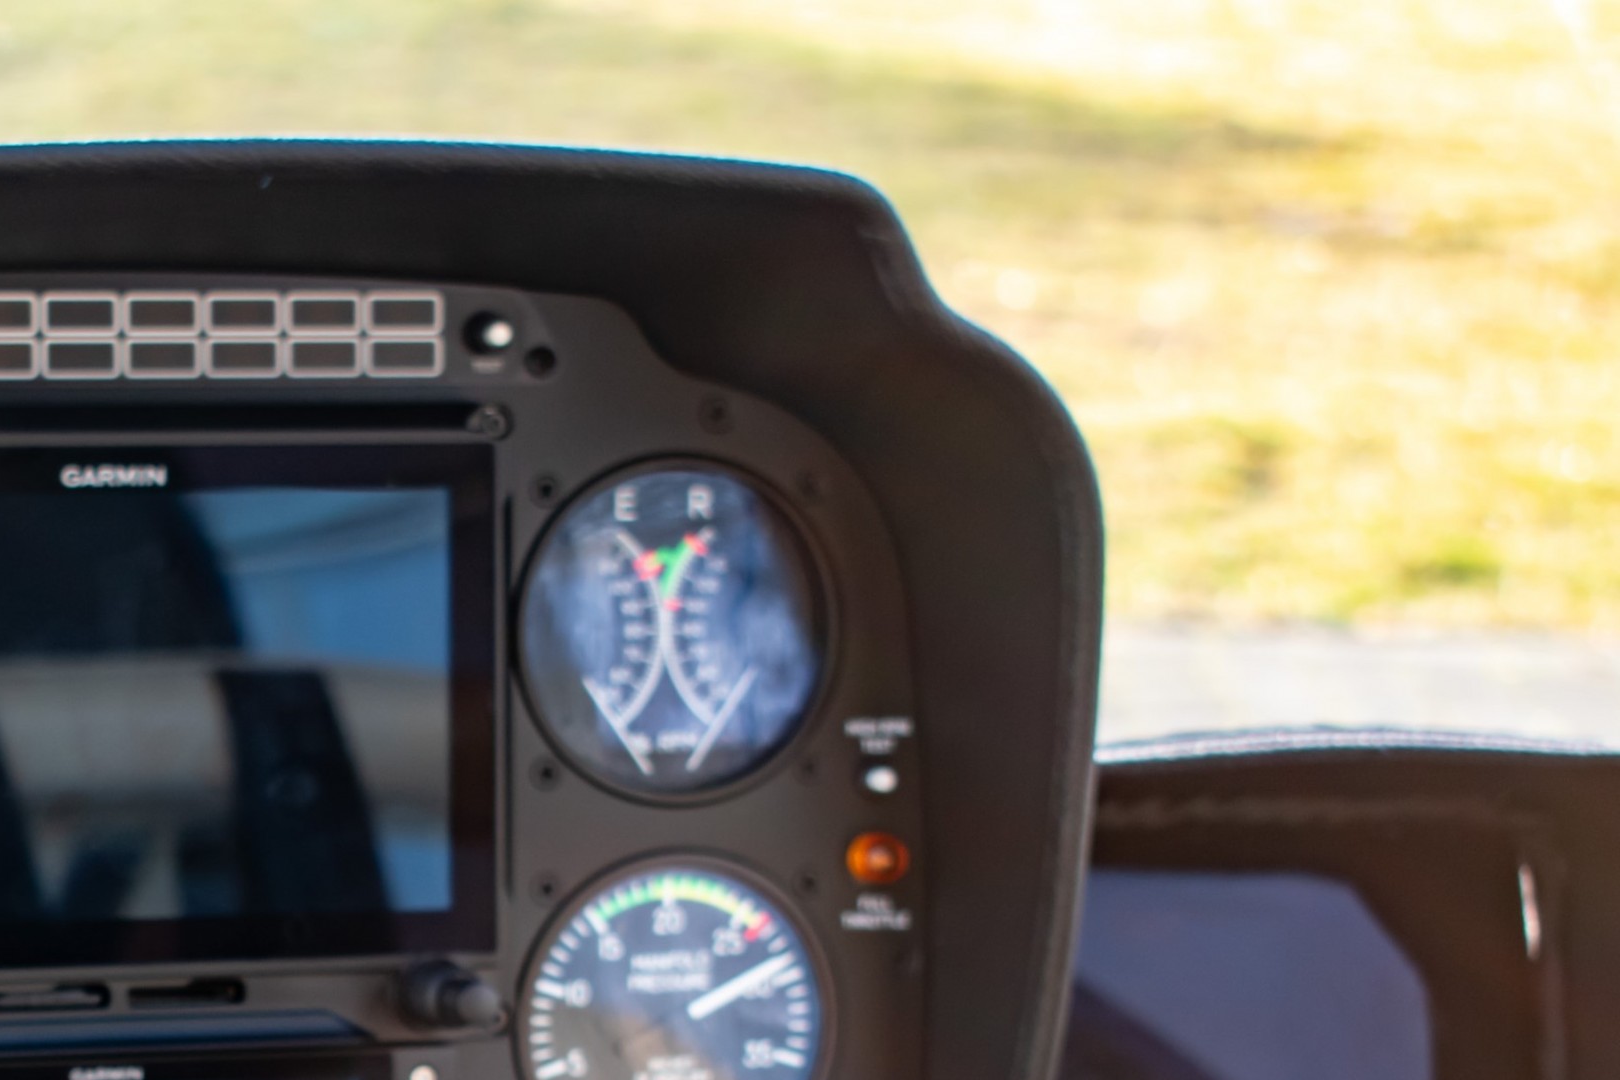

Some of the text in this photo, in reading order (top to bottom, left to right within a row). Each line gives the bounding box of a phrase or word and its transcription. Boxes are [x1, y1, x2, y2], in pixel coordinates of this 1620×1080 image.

[60, 464, 168, 488] GARMIN
[613, 487, 638, 522] E
[687, 485, 714, 520] R
[652, 904, 687, 935] 20
[713, 927, 748, 957] 25
[742, 1038, 774, 1069] 35
